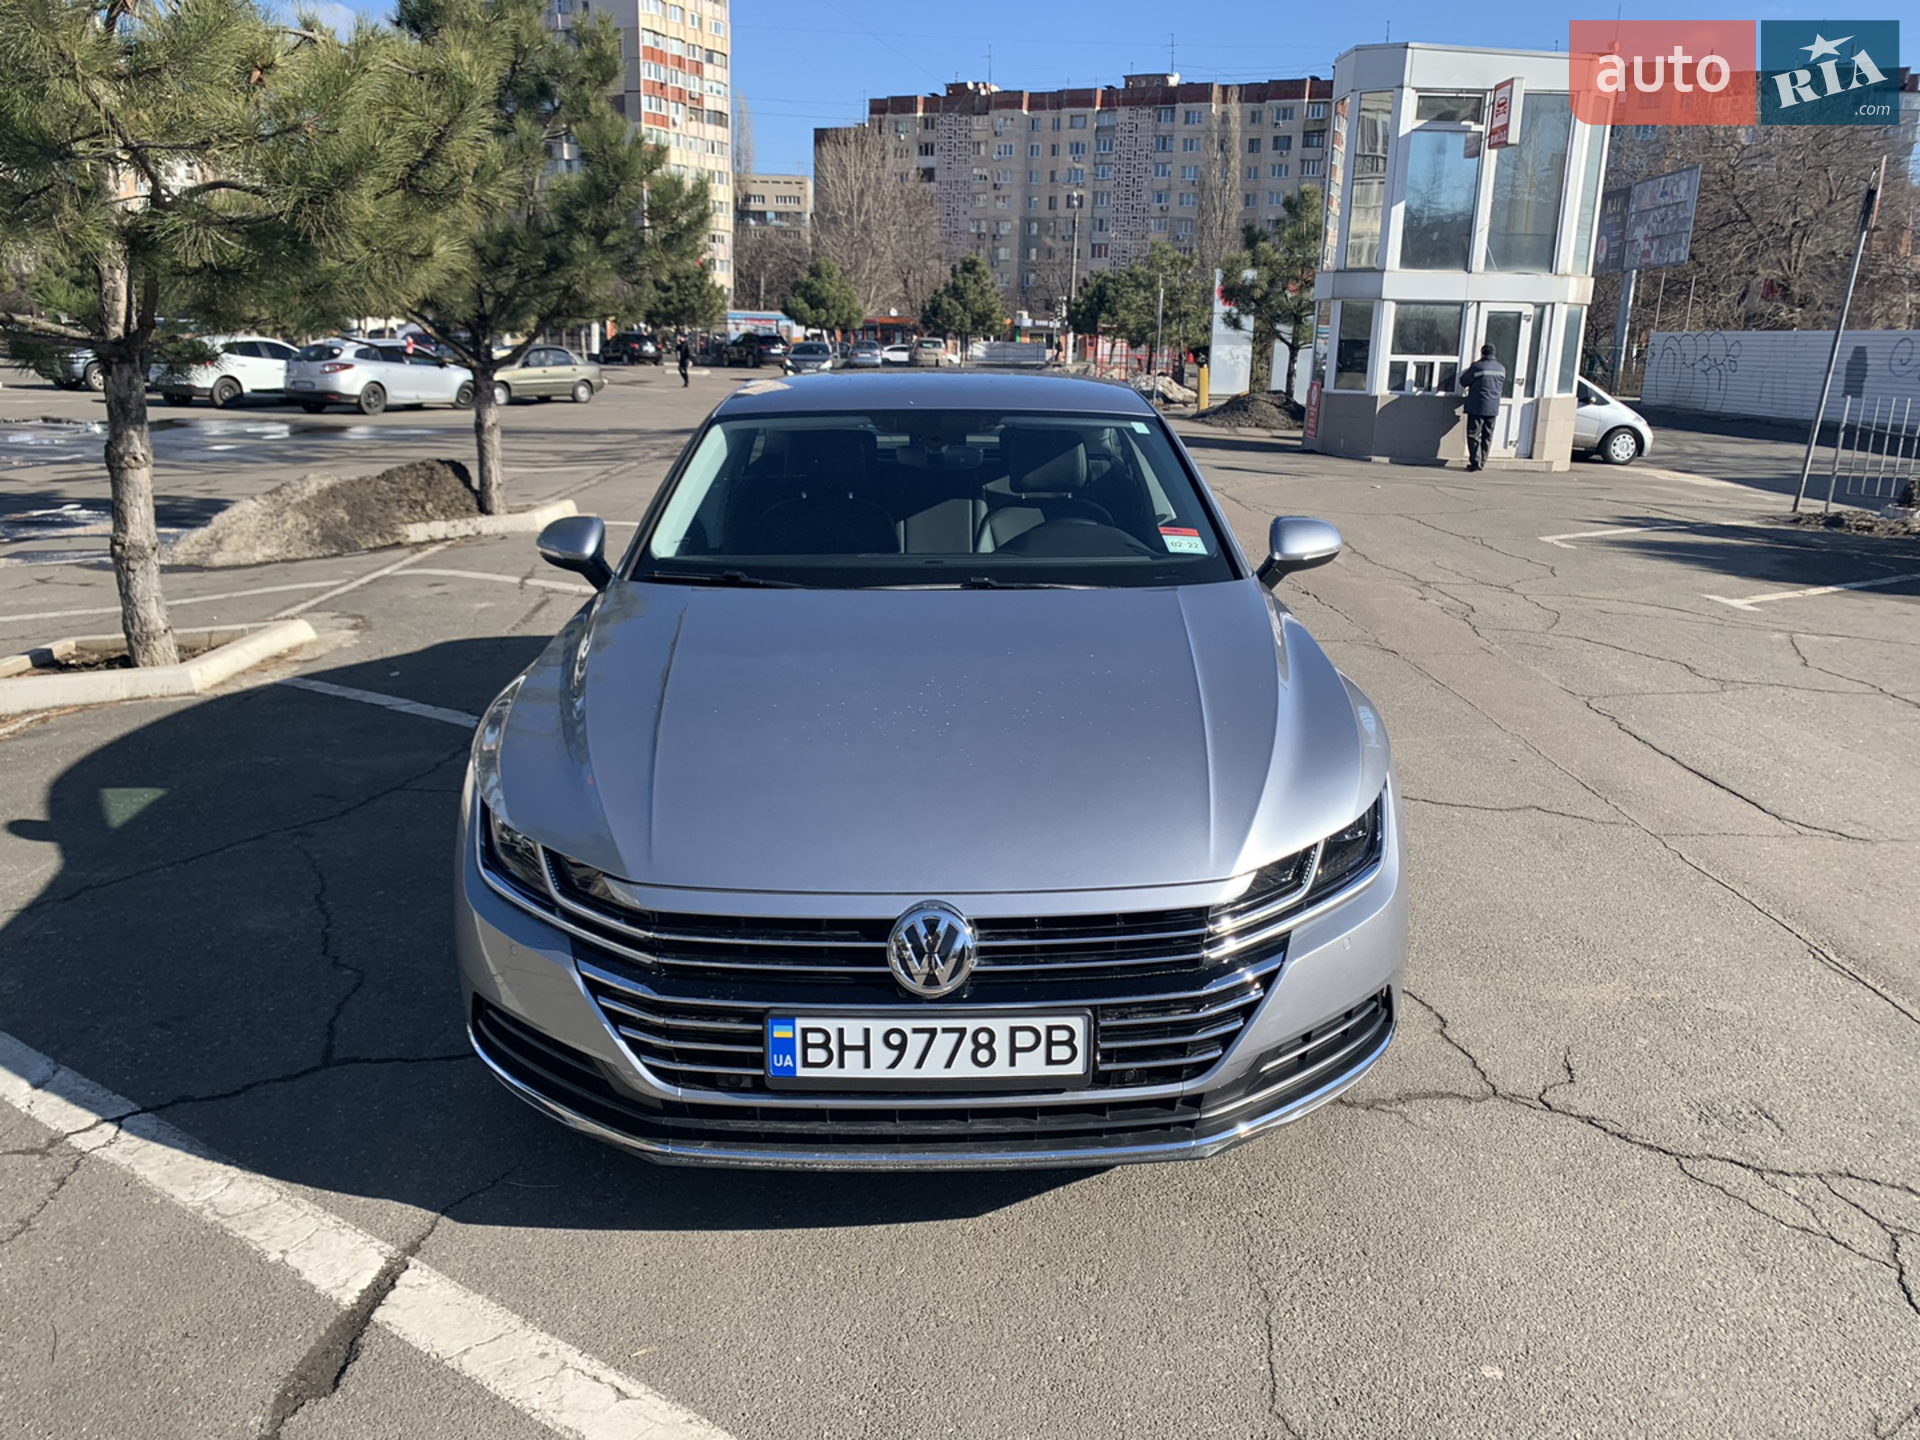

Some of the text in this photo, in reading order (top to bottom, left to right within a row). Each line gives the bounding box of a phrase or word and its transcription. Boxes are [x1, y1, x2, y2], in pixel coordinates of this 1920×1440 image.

[773, 1054, 794, 1067] UA
[801, 1024, 1079, 1069] BH 9778 PB
